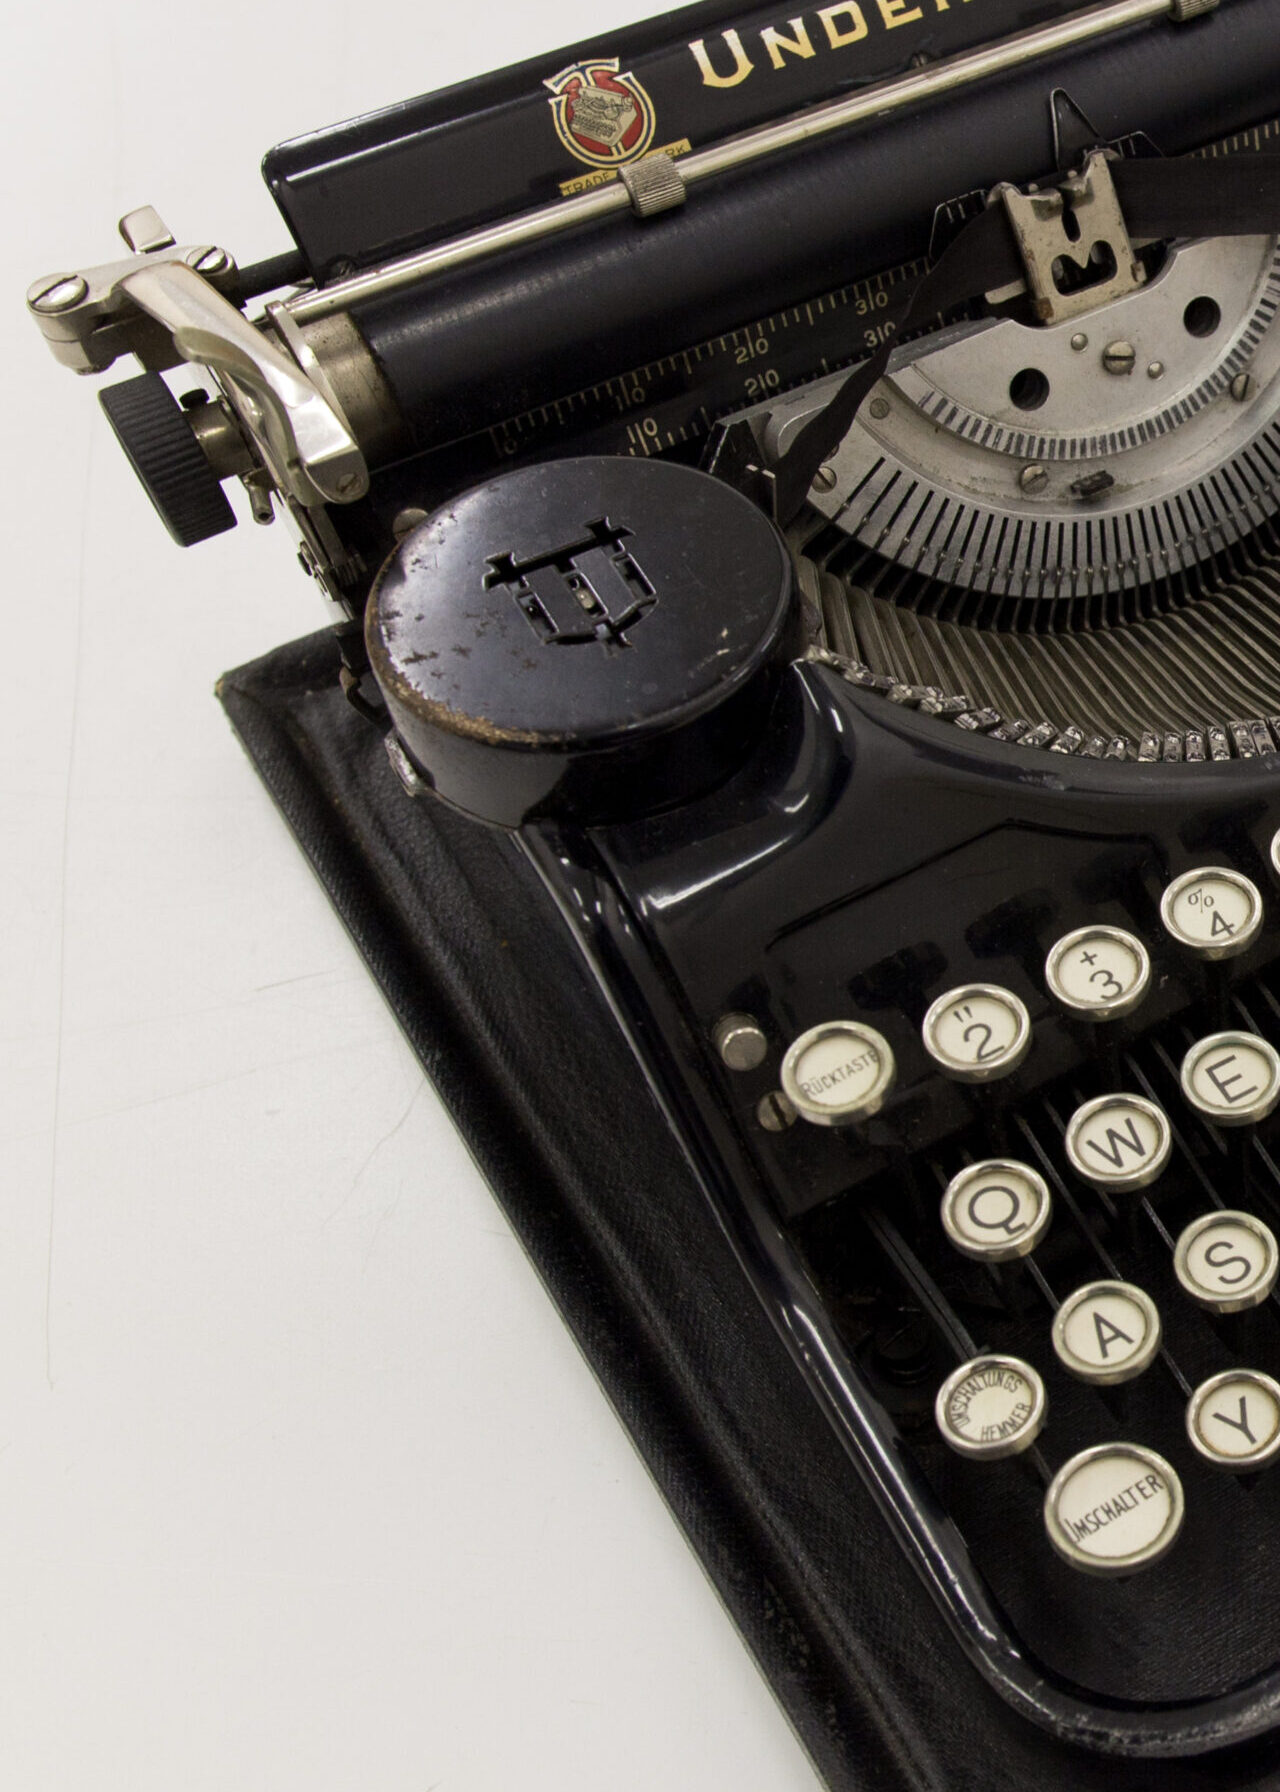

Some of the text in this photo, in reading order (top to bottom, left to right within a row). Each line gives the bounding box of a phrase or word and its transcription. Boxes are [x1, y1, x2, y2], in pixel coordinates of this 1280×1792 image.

[688, 0, 978, 88] UNDE
[1210, 910, 1235, 937] 4
[1089, 969, 1123, 1000] 3
[963, 1023, 1005, 1060] 2
[1204, 1054, 1258, 1104] E
[1085, 1117, 1147, 1169] W
[968, 1185, 1027, 1235] Q
[1204, 1241, 1251, 1284] S
[1093, 1311, 1135, 1359] A
[980, 1403, 1031, 1442] HEMMER
[1212, 1396, 1257, 1445] Y
[1064, 1474, 1163, 1544] UMSCHALTER
